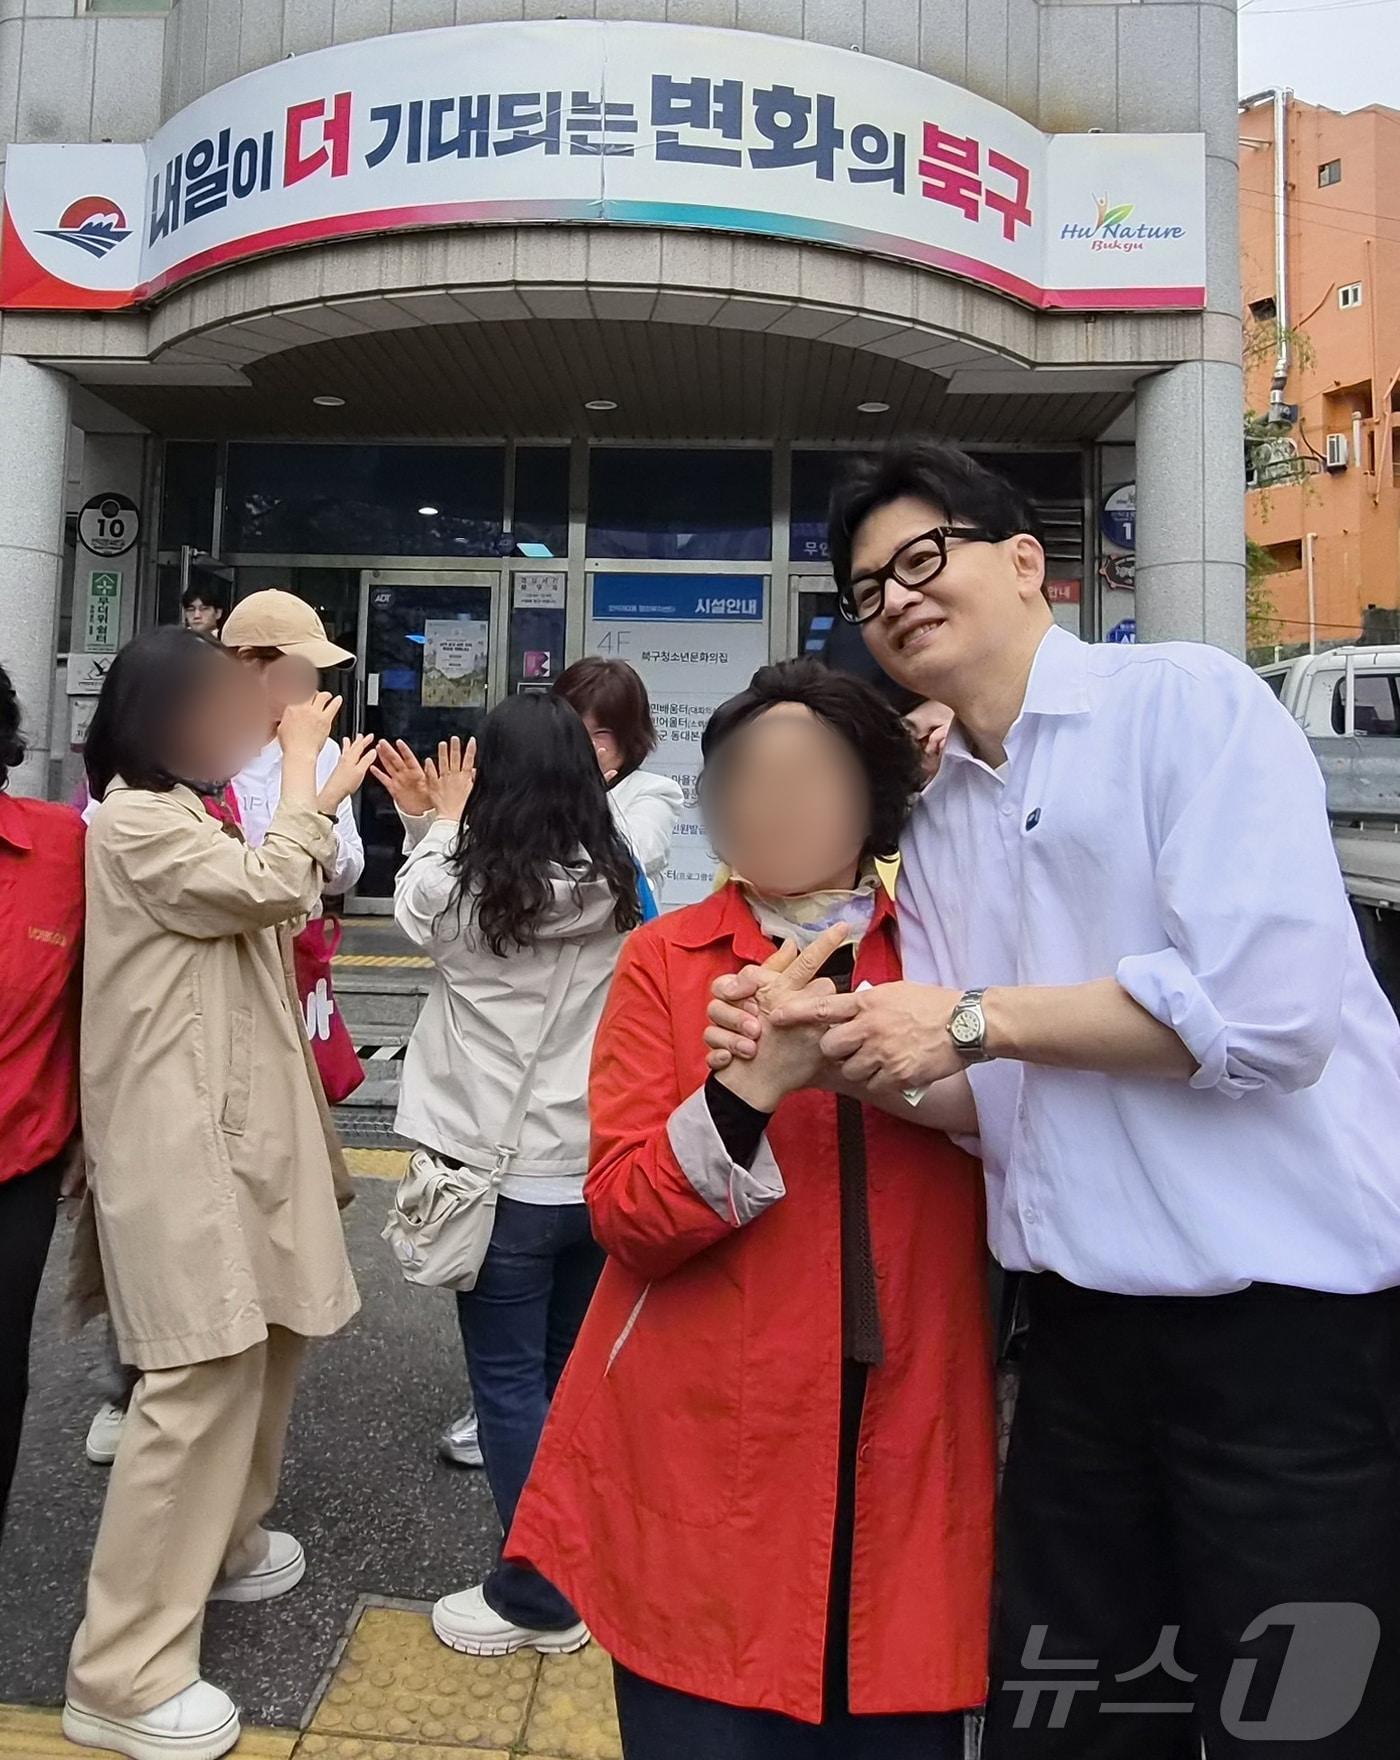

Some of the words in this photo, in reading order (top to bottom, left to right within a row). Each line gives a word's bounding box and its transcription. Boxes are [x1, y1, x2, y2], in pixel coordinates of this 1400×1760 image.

[149, 128, 274, 248] 내일이
[283, 91, 352, 188] 더
[365, 90, 635, 168] 기대되는
[651, 74, 905, 195] 변화의
[918, 120, 1032, 242] 북구
[1102, 223, 1185, 239] Nature
[1091, 240, 1143, 252] Bukgu
[97, 519, 125, 537] 10
[695, 598, 757, 614] 시설안내
[96, 597, 109, 643] 무더위쉼터
[597, 631, 631, 654] 4F
[642, 651, 728, 663] 북구청소년문화의집
[672, 730, 701, 742] 동대본
